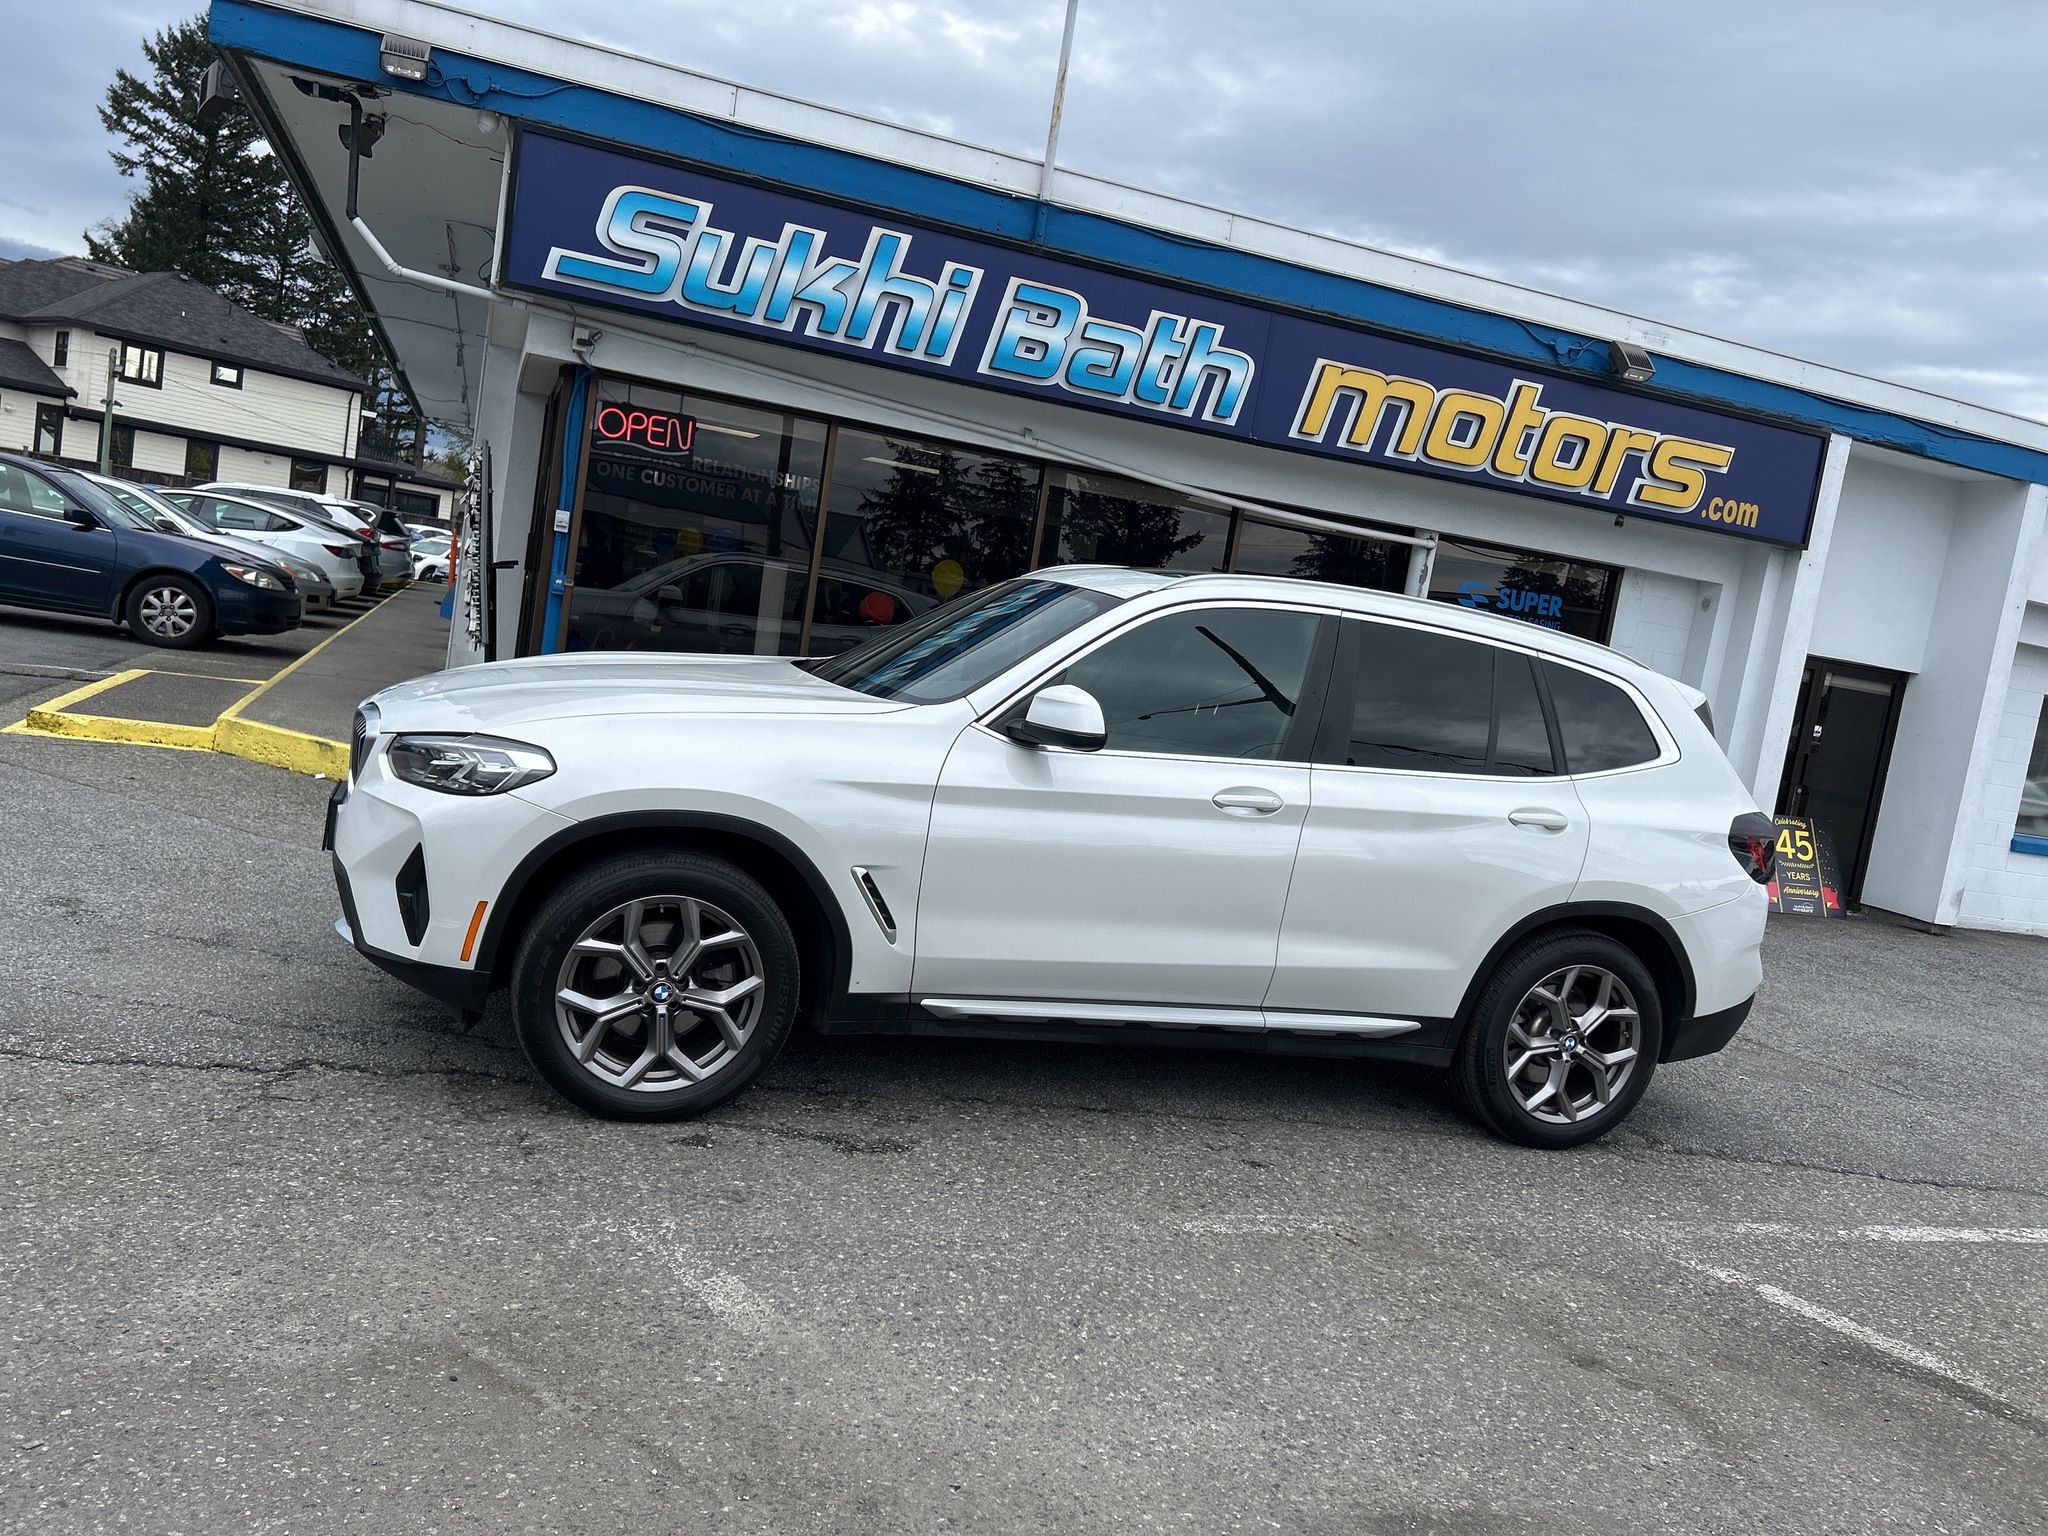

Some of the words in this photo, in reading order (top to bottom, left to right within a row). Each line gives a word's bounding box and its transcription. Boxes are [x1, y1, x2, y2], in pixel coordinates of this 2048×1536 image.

[541, 185, 984, 367] Sukhi
[978, 277, 1254, 427] Bath
[1288, 357, 1736, 513] motors
[1701, 495, 1760, 529] .com
[597, 407, 693, 450] OPEN
[596, 461, 635, 481] ONE
[640, 468, 736, 499] CUSTOMER
[741, 487, 762, 504] AT
[765, 492, 777, 507] A
[692, 455, 820, 493] RELATIONSHIPS
[1496, 588, 1563, 618] SUPER
[1774, 817, 1807, 830] Celebrating
[1775, 829, 1814, 861] 45
[1786, 871, 1811, 881] YEARS
[1783, 886, 1821, 899] Anniversary
